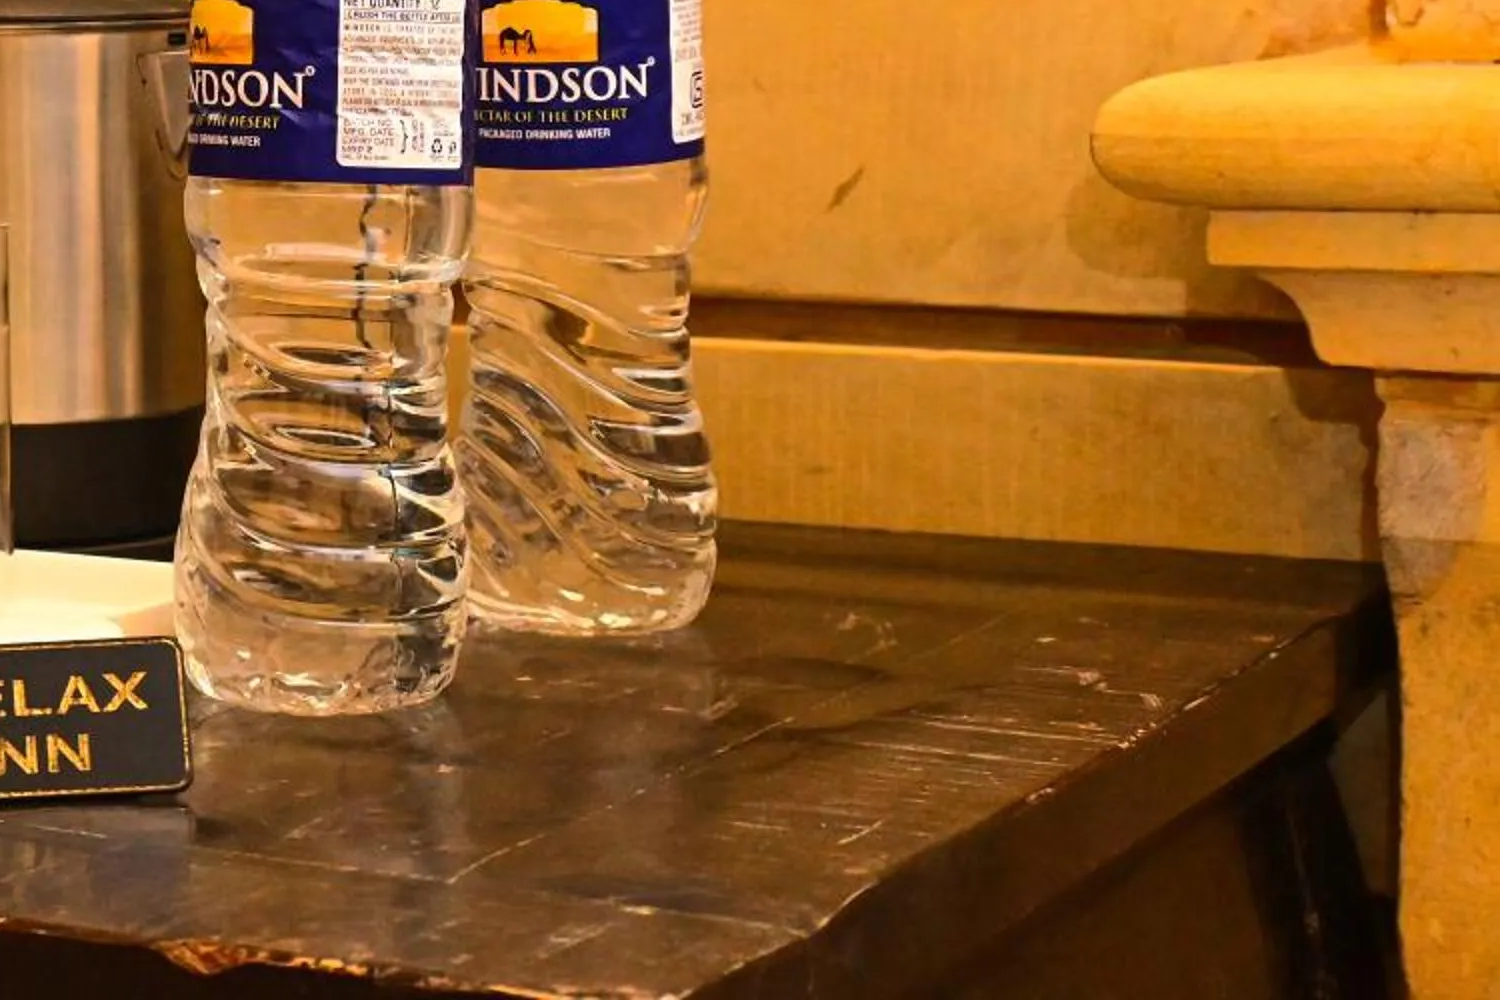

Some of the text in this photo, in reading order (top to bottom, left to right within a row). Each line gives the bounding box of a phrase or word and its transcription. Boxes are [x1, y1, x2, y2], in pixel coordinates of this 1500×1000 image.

[475, 63, 649, 103] INDSON
[515, 110, 534, 123] OF
[539, 110, 569, 123] THE
[574, 107, 629, 123] DESERT
[229, 115, 280, 130] DESERT
[369, 127, 396, 137] DATE
[525, 128, 574, 140] DRINKING
[575, 127, 611, 140] WATER
[230, 135, 261, 147] WATER
